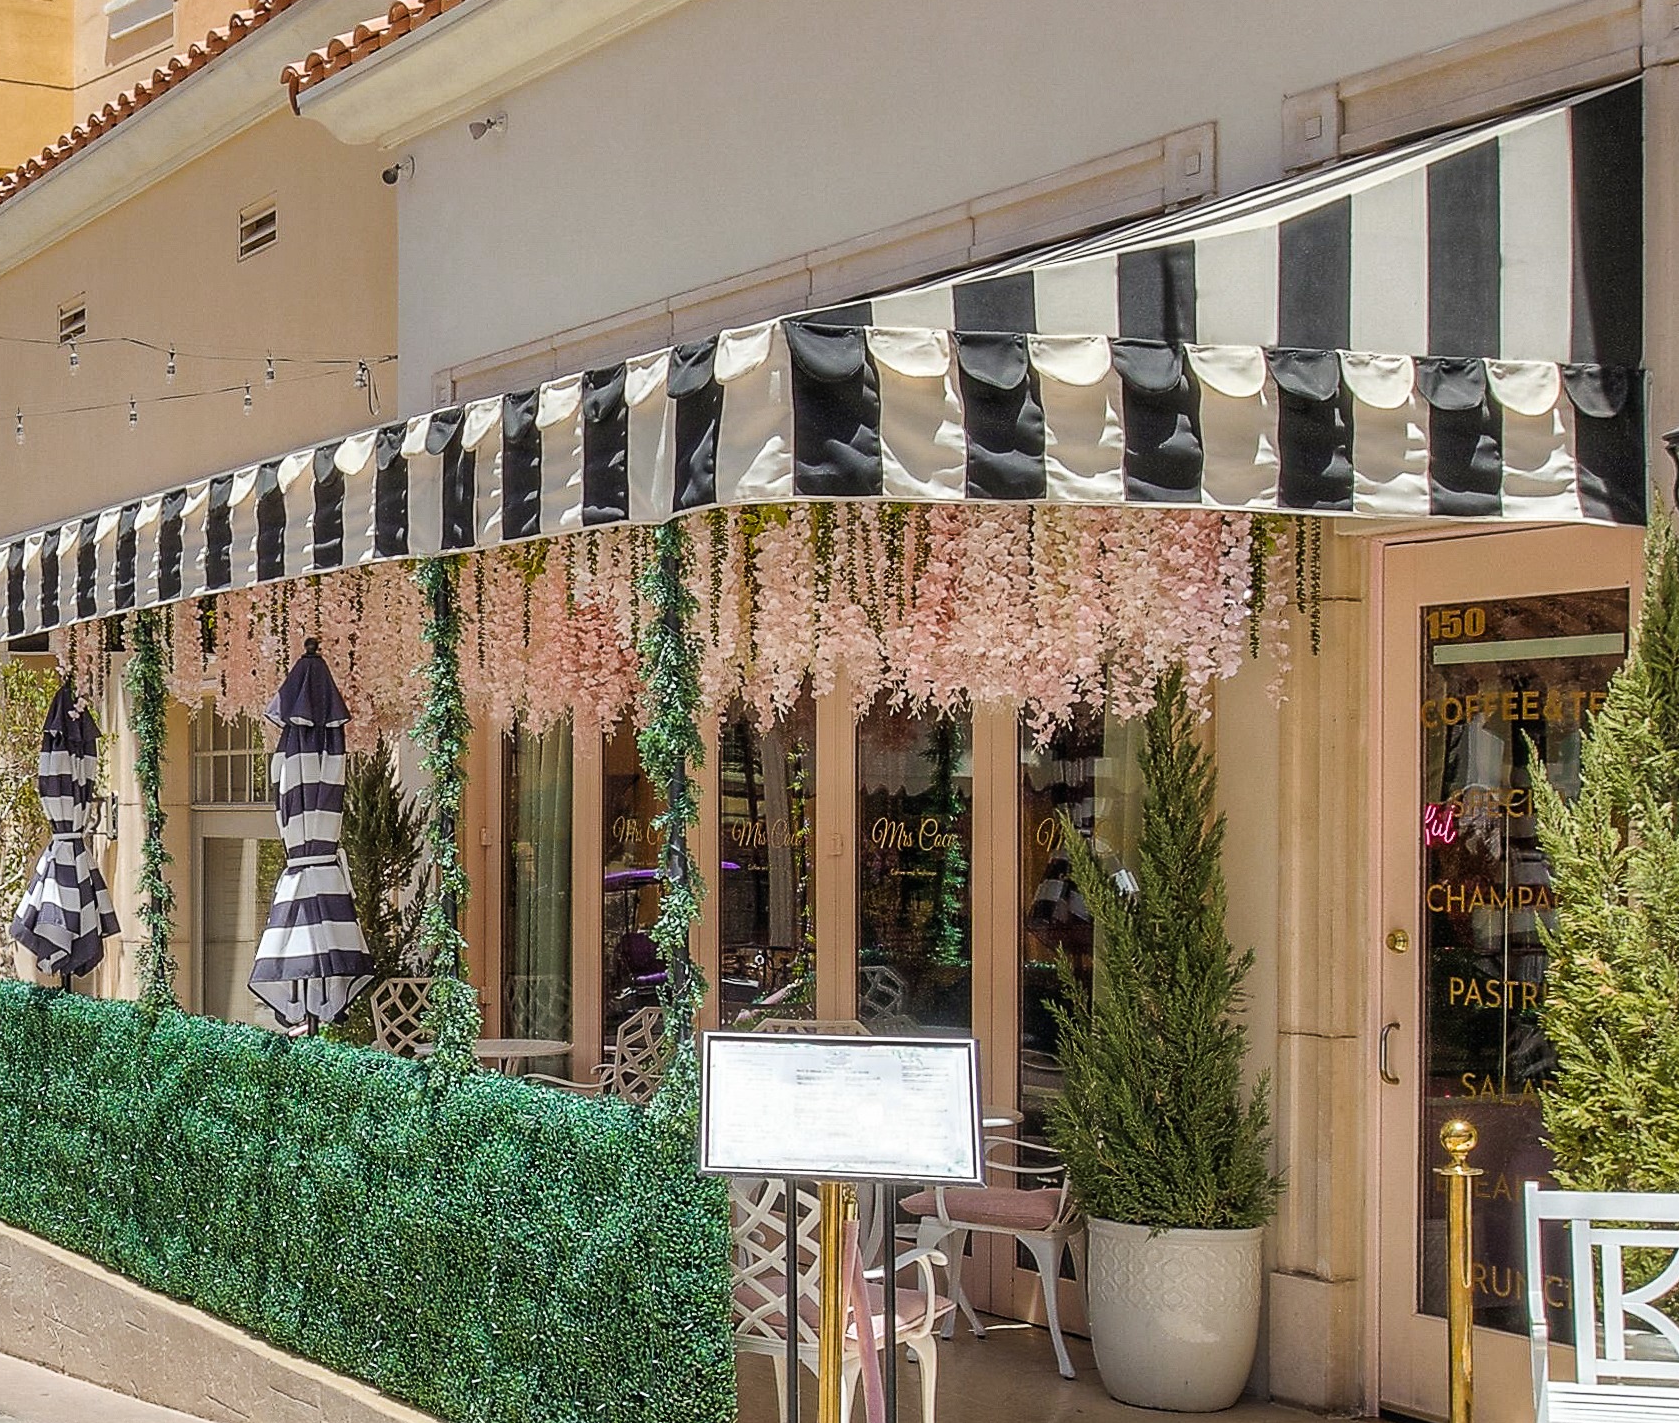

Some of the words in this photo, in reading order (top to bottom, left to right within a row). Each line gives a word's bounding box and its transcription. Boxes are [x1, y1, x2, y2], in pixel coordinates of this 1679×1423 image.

[1425, 606, 1487, 640] 150
[871, 817, 913, 851] Mrs
[1426, 884, 1559, 914] CHAMPA
